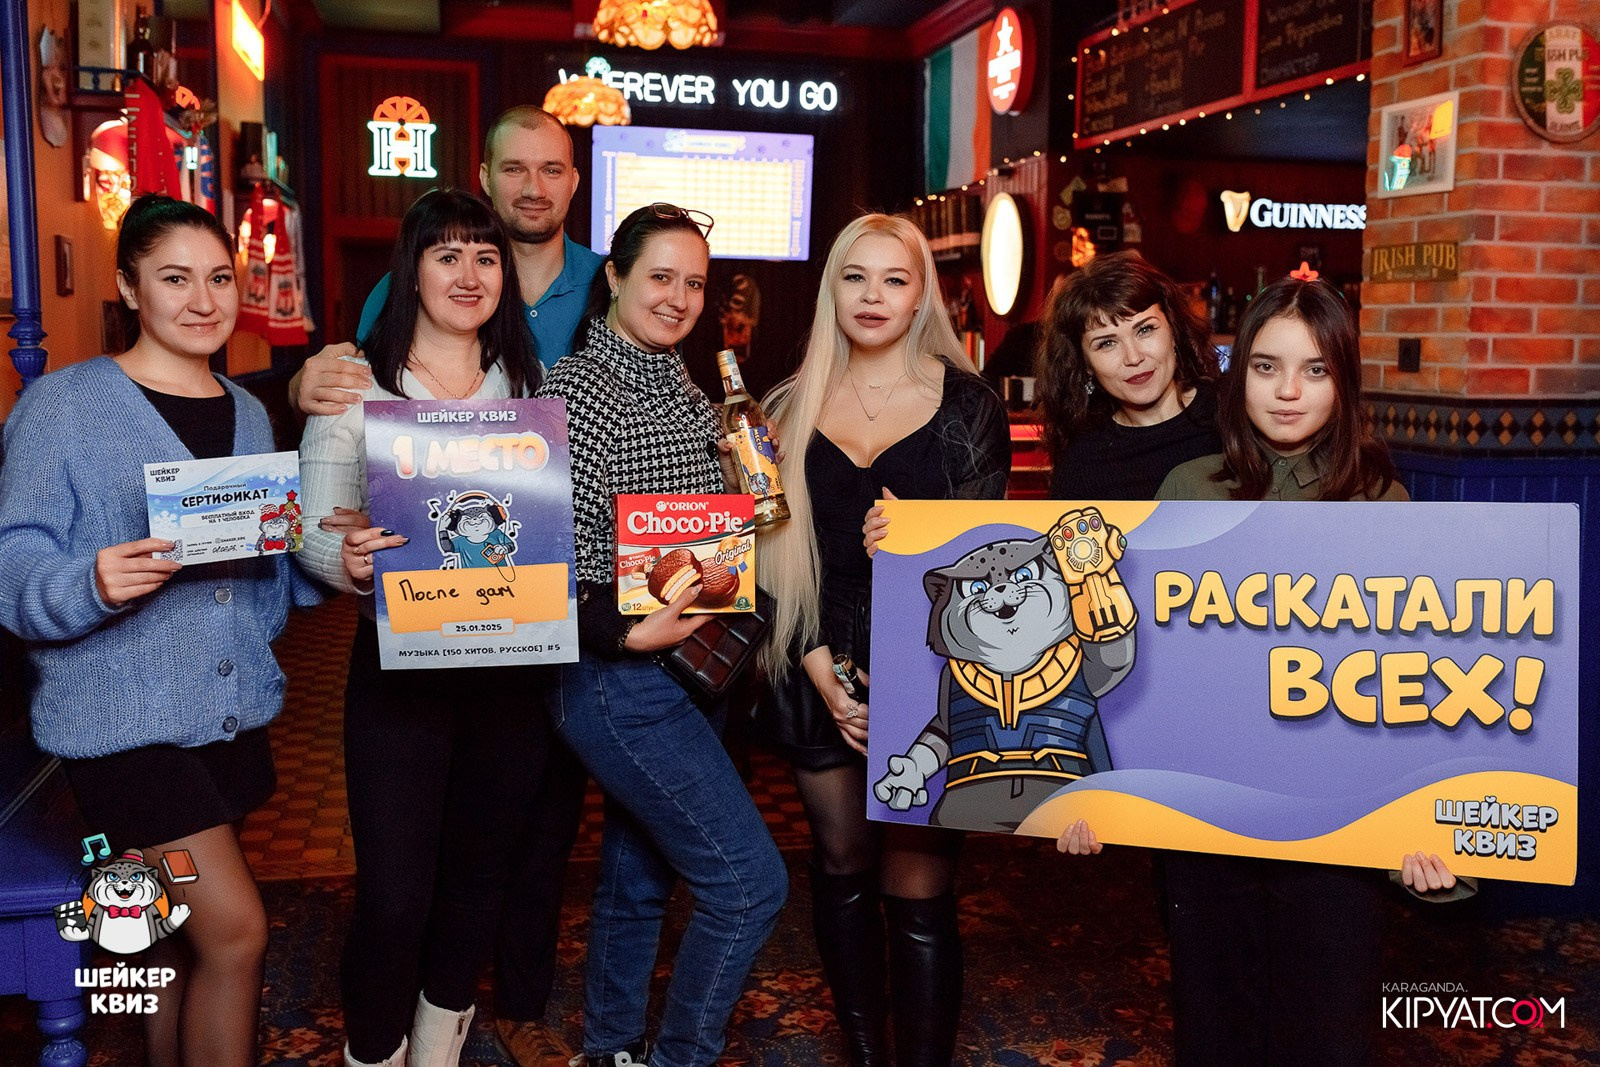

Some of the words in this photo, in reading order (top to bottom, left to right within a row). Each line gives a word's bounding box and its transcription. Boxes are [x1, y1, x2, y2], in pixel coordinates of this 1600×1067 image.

[558, 68, 715, 104] EREVER
[732, 78, 789, 109] YOU
[800, 81, 838, 111] GO
[1373, 245, 1415, 275] IRISH
[1423, 243, 1456, 270] PUB
[417, 409, 474, 423] ШЕЙКЕР
[479, 410, 517, 422] КВИЗ
[391, 435, 418, 478] 1
[423, 432, 549, 478] МЕСТО
[150, 468, 180, 476] ШЕЙКЕР
[155, 475, 176, 483] КВИЗ
[181, 488, 269, 508] СЕРТИФИКАТ
[669, 501, 706, 511] ORION
[714, 539, 752, 565] Original
[398, 578, 460, 602] После
[475, 585, 516, 606] дам
[1154, 570, 1556, 640] РАСКАТАЛИ
[632, 602, 642, 611] 12
[455, 623, 502, 632] 25.01.2025
[442, 648, 462, 657] [150
[499, 644, 543, 654] РУССКОЕ]
[547, 644, 561, 652] #5
[1269, 646, 1546, 735] ВСЕХ!
[1435, 796, 1559, 832] ШЕЙКЕР
[1453, 828, 1537, 861] КВИЗ
